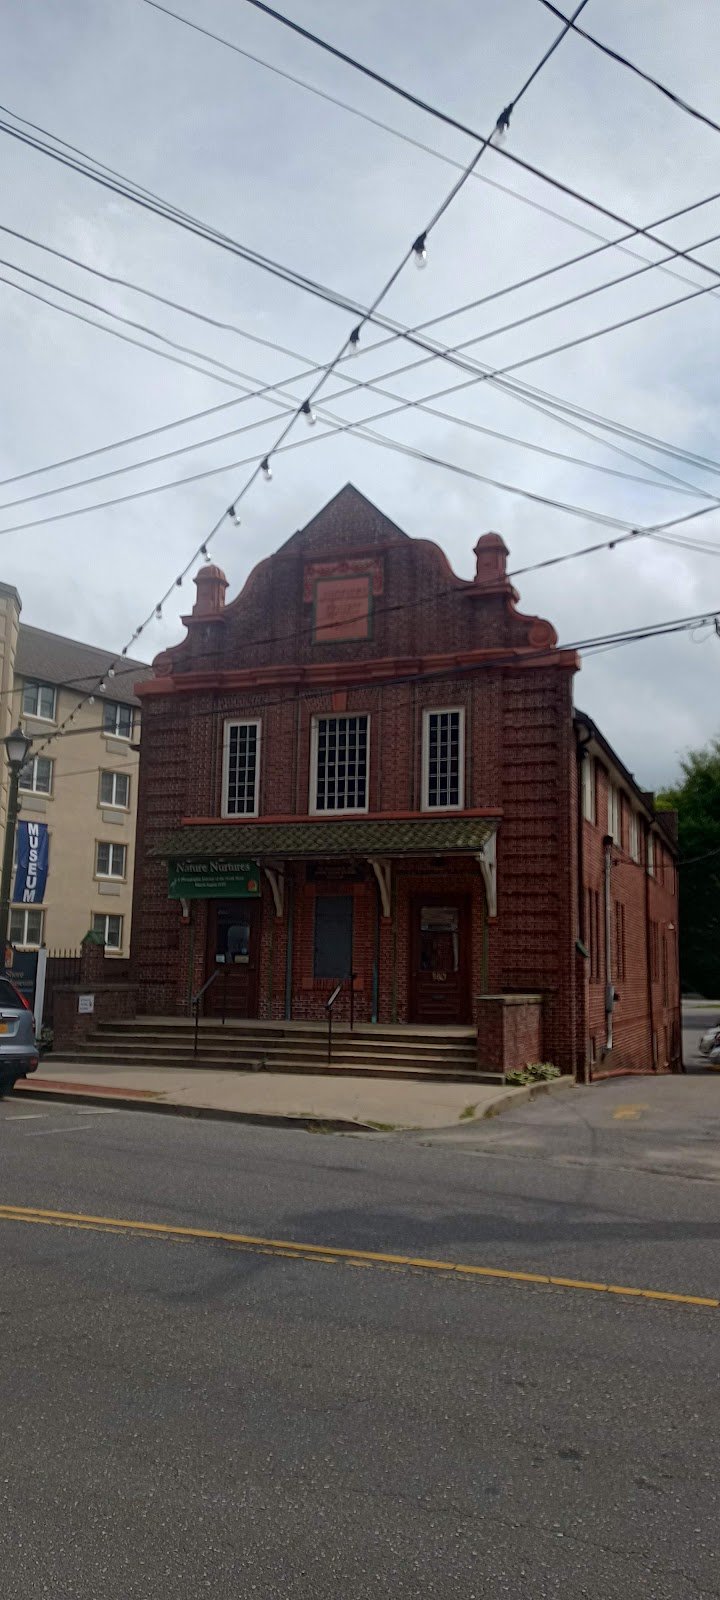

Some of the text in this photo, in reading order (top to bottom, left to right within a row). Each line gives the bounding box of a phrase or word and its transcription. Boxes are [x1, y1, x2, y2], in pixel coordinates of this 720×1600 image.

[22, 822, 39, 903] MUSEUM
[176, 861, 251, 873] Nature Nurtures
